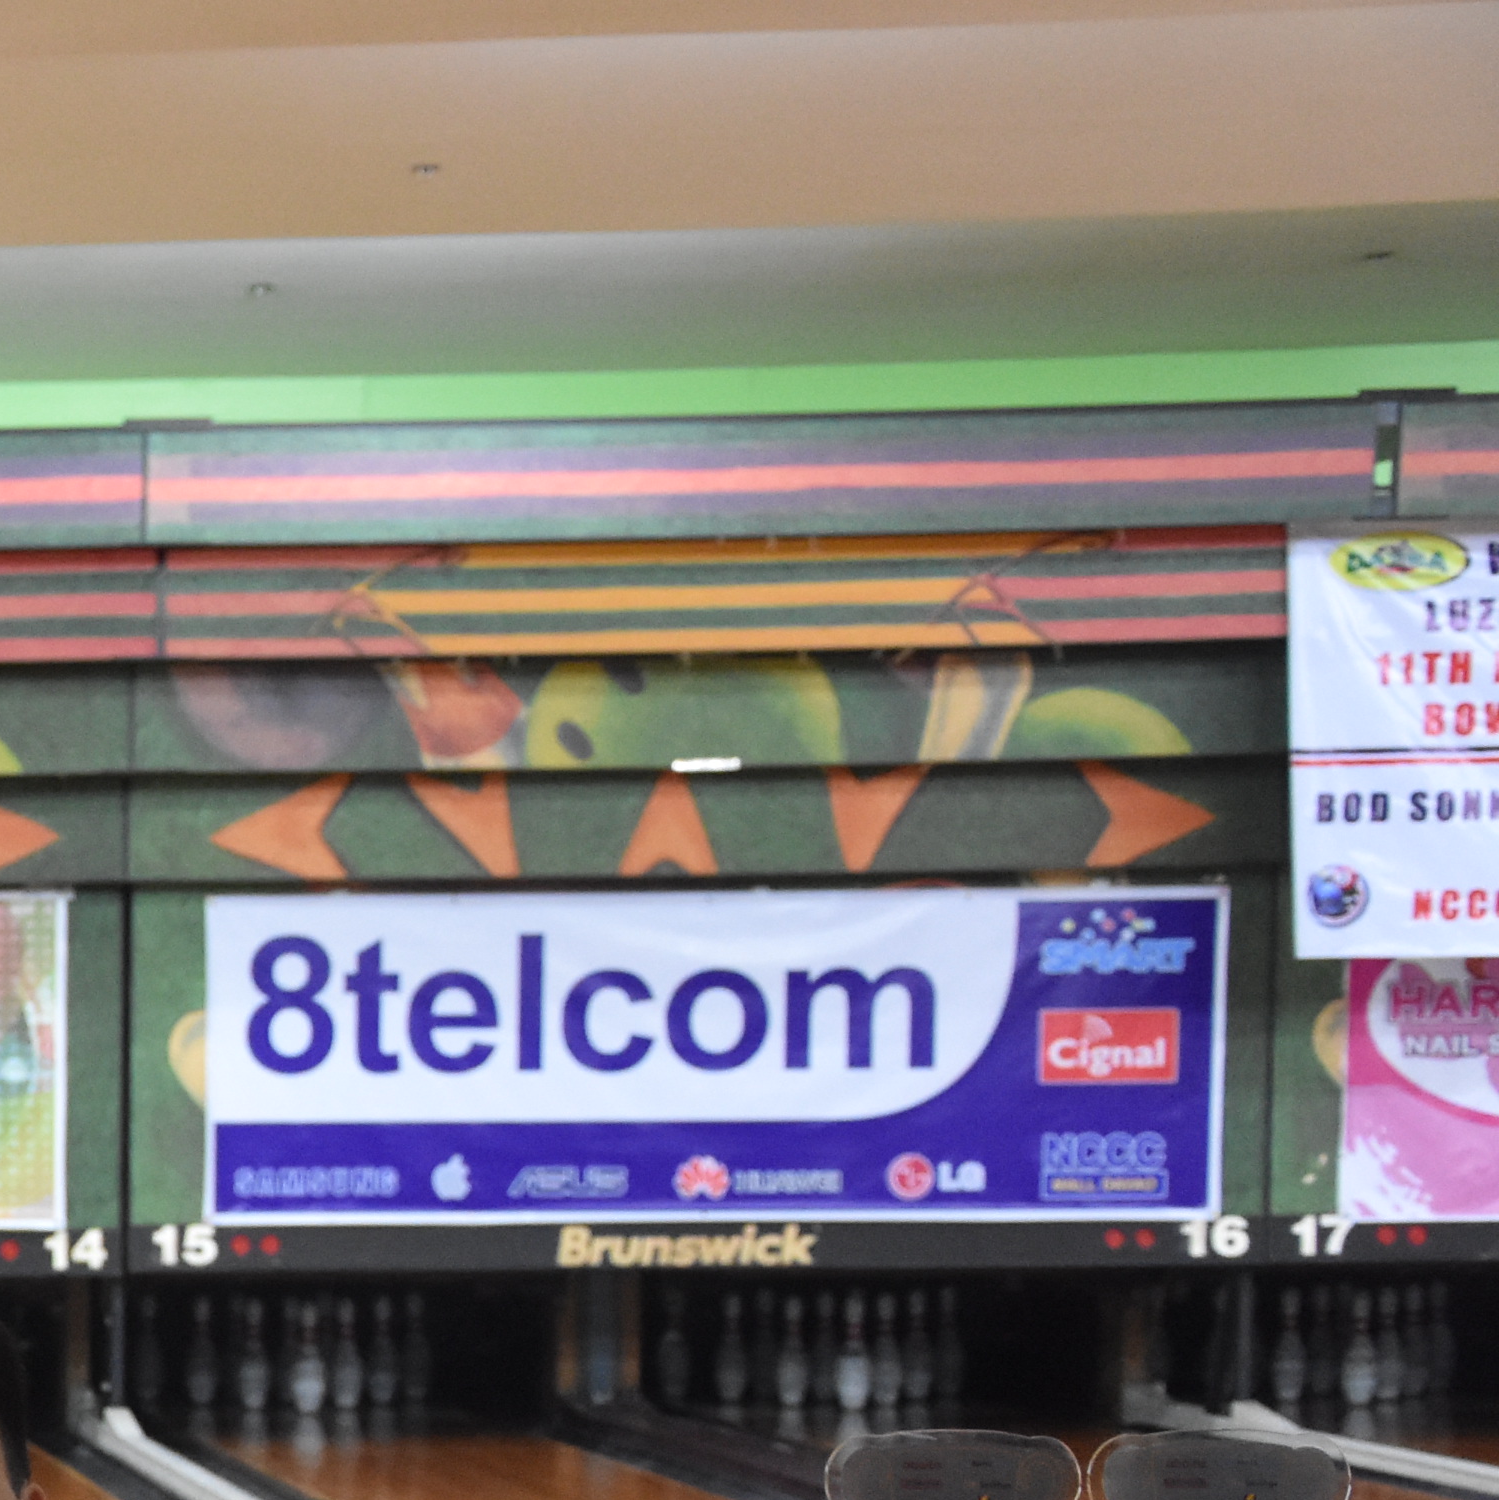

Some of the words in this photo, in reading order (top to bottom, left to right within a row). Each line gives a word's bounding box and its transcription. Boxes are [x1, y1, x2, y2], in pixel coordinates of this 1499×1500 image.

[1377, 651, 1473, 685] 11TH
[1413, 889, 1499, 920] NCC
[244, 932, 937, 1076] 8telcom
[1047, 1036, 1166, 1077] Cignal
[1403, 1034, 1480, 1058] NAIL
[233, 1165, 400, 1198] SAMSUNG
[734, 1168, 844, 1195] HUAWEI
[937, 1160, 987, 1194] LG
[44, 1230, 109, 1270] 14
[151, 1224, 218, 1267] 15
[556, 1224, 818, 1269] Brunswick
[1179, 1215, 1250, 1259] 16
[1291, 1216, 1353, 1257] 17
